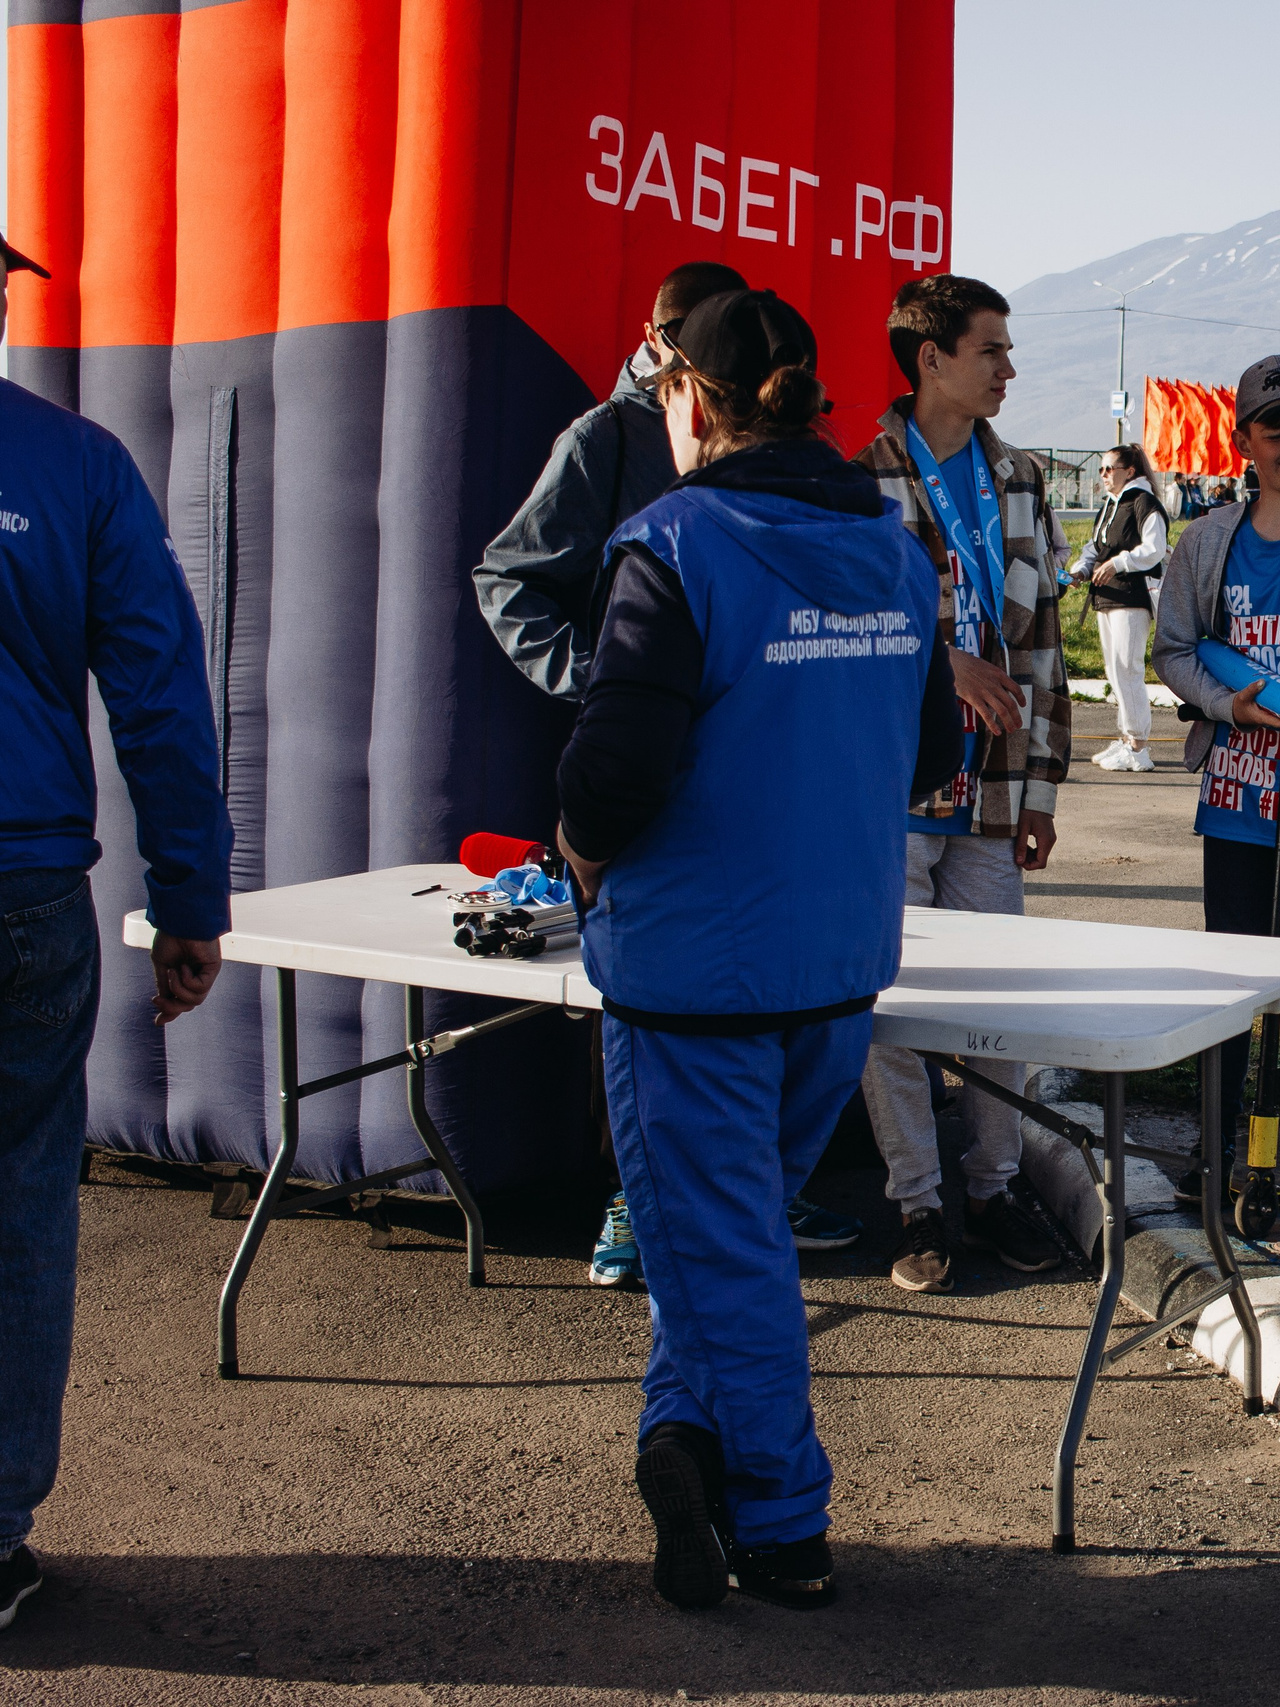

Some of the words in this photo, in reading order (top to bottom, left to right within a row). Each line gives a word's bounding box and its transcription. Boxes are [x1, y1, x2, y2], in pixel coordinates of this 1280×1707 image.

[978, 466, 988, 487] ПСБ
[934, 487, 950, 510] ПСБ
[953, 586, 981, 624] 024
[1223, 585, 1253, 616] 024
[790, 609, 820, 635] МБУ
[824, 611, 910, 636] «Физкультурно-
[766, 633, 873, 665] оздоровительный
